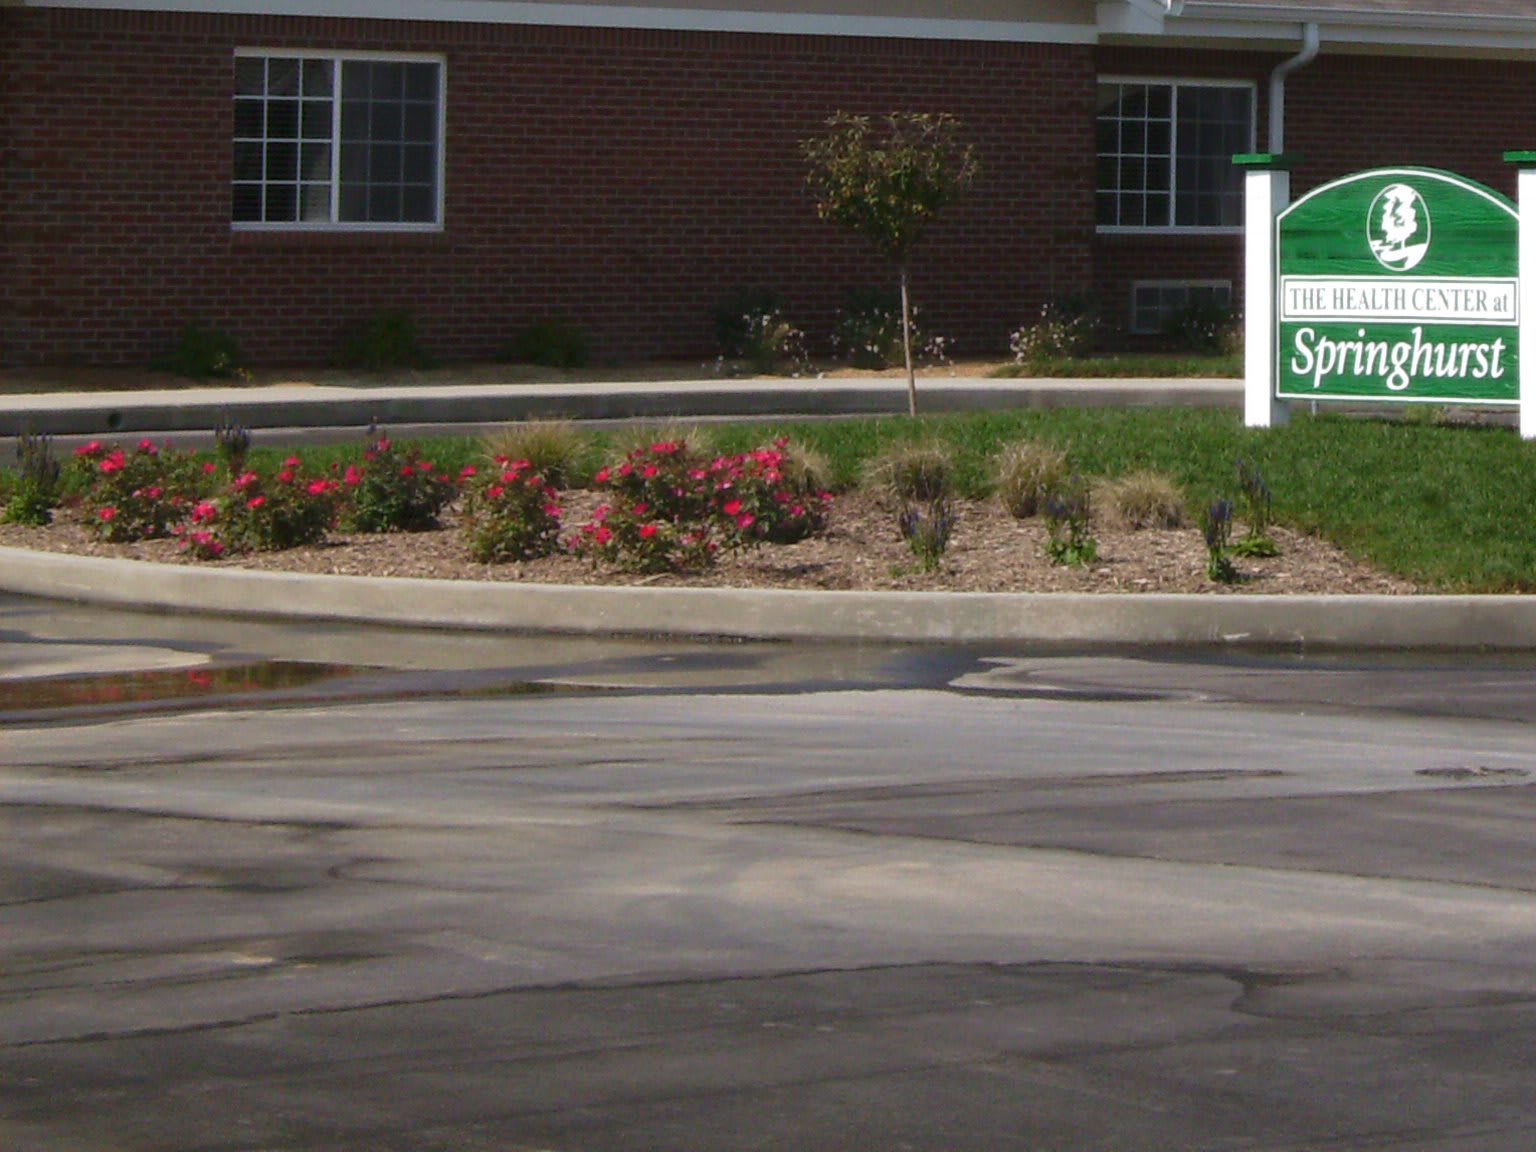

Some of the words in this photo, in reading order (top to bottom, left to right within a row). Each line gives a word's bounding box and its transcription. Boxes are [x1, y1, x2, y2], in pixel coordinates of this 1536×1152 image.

[1290, 286, 1327, 311] THE
[1332, 288, 1407, 311] HEALTH
[1412, 288, 1489, 313] CENTER
[1493, 292, 1508, 313] at
[1291, 327, 1506, 390] Springhurst
